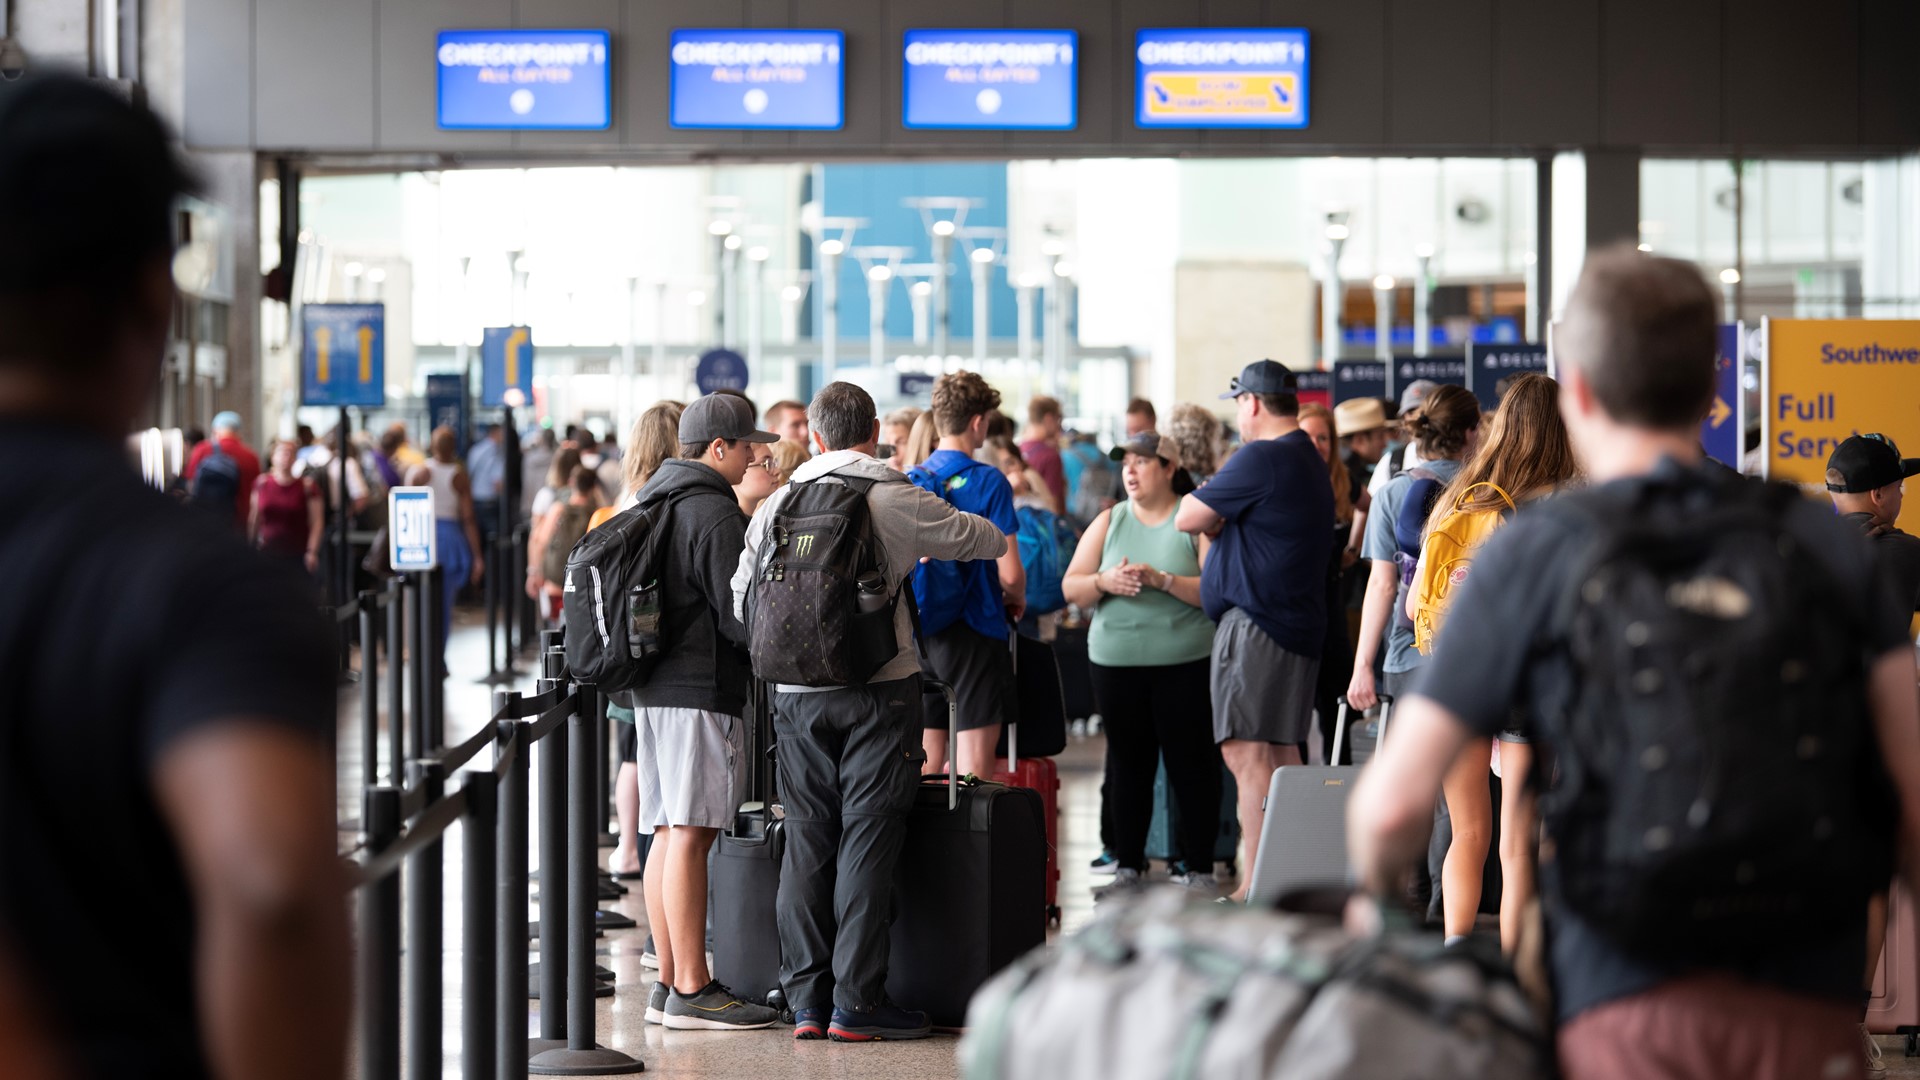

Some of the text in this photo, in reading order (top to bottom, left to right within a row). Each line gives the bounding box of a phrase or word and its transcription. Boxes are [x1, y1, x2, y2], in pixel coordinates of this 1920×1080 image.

[439, 43, 590, 66] CHECKPOINT
[672, 42, 823, 66] CHECKPOINT
[905, 42, 1056, 66] CHECKPOINT
[1138, 42, 1288, 65] CHECKPOINT
[1821, 343, 1920, 364] Southwe
[1778, 393, 1835, 421] Full
